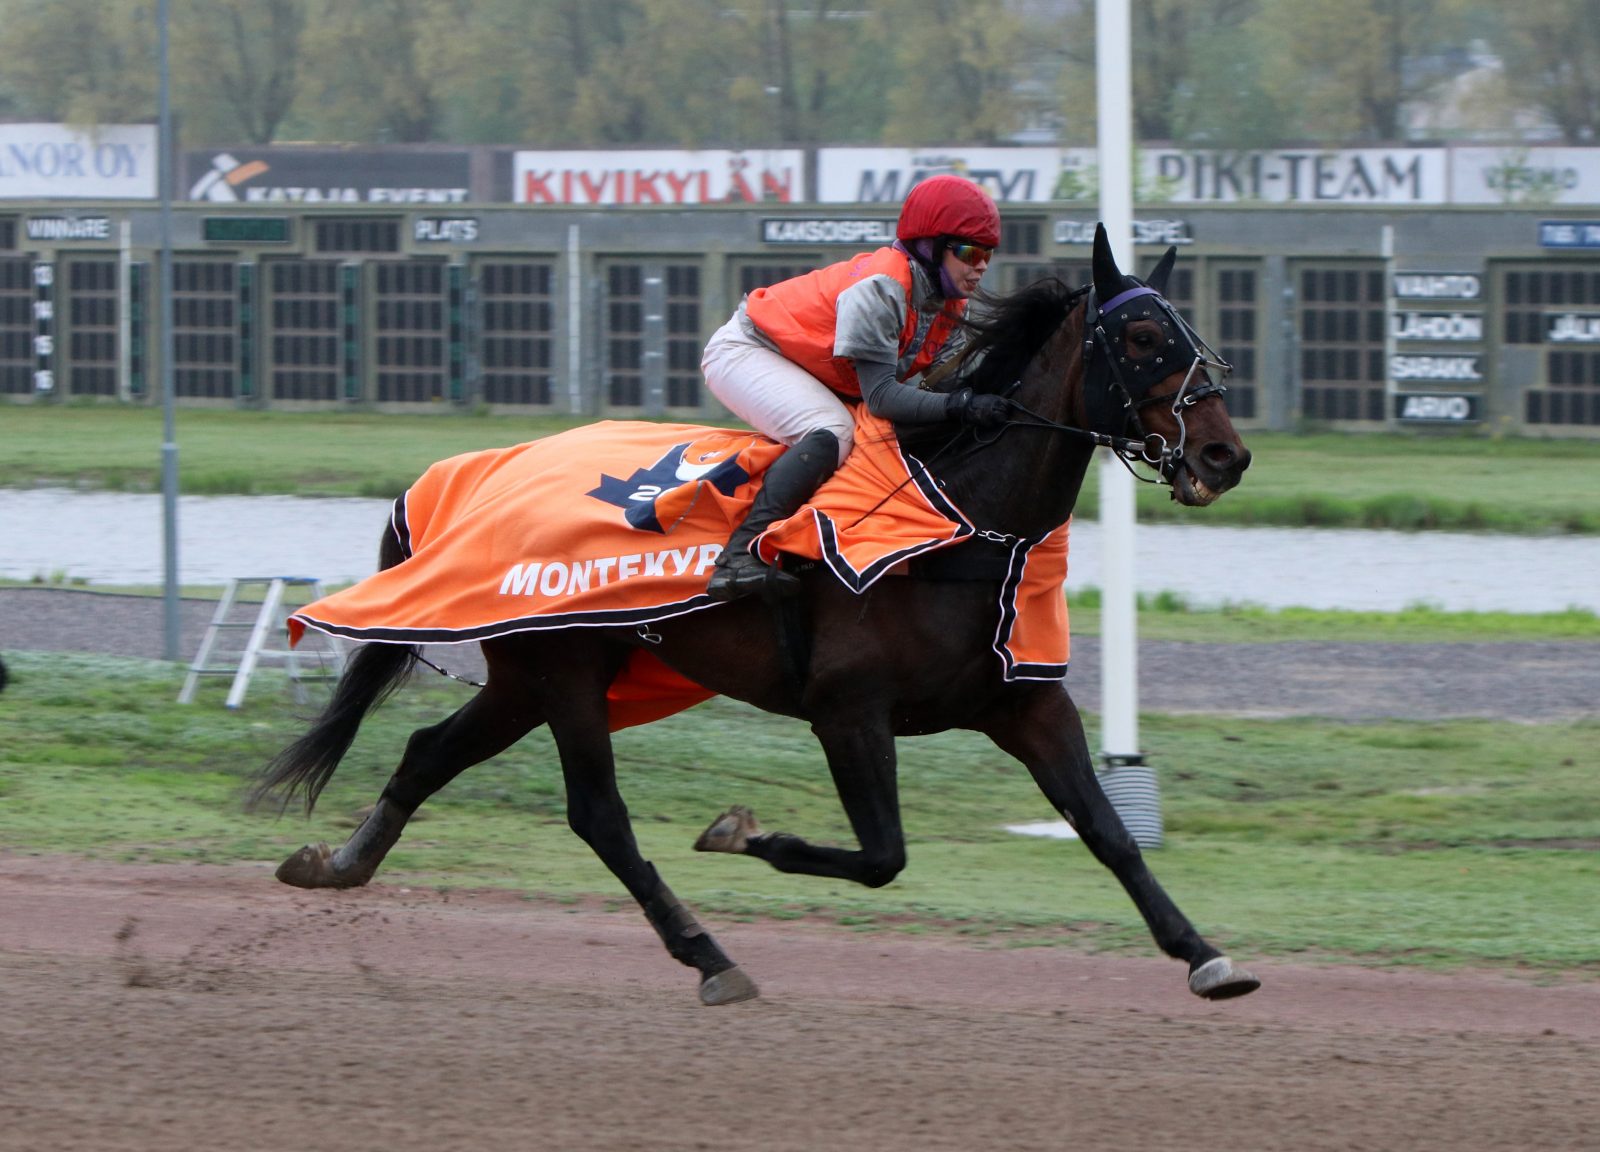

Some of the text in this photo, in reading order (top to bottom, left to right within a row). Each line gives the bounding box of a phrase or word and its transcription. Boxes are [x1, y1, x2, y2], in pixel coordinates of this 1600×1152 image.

[96, 142, 146, 178] OY
[1158, 153, 1421, 200] PIKI-TEAM
[416, 219, 478, 241] PLATS
